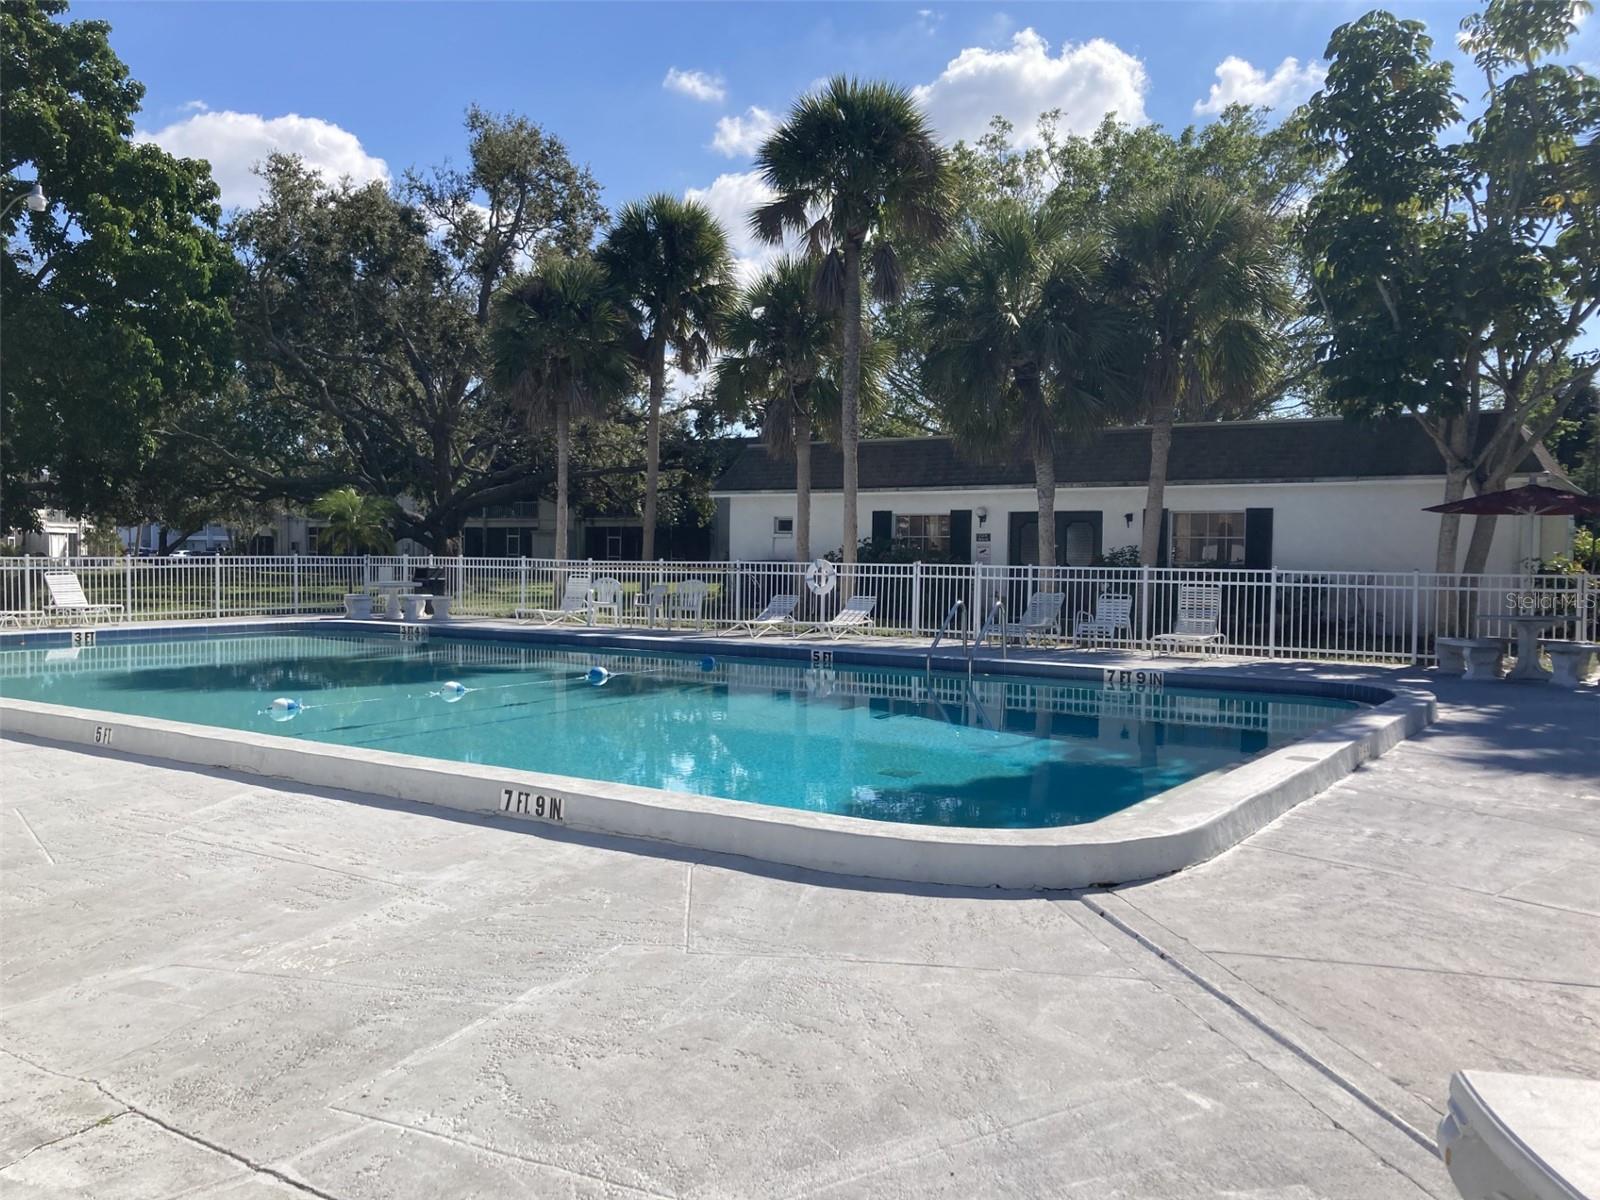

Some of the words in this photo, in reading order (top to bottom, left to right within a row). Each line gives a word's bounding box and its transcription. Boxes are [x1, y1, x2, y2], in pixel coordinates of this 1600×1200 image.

[74, 632, 82, 642] 3
[84, 632, 94, 642] FT
[813, 651, 820, 662] 5
[823, 652, 832, 662] FT
[1107, 670, 1116, 682] 7
[1120, 671, 1132, 682] FT
[1136, 672, 1146, 684] 9
[1150, 672, 1162, 685] IN
[96, 726, 102, 742] 5
[102, 728, 112, 744] FT
[504, 790, 512, 811] 7
[517, 792, 530, 814] FT.
[536, 796, 546, 816] 9
